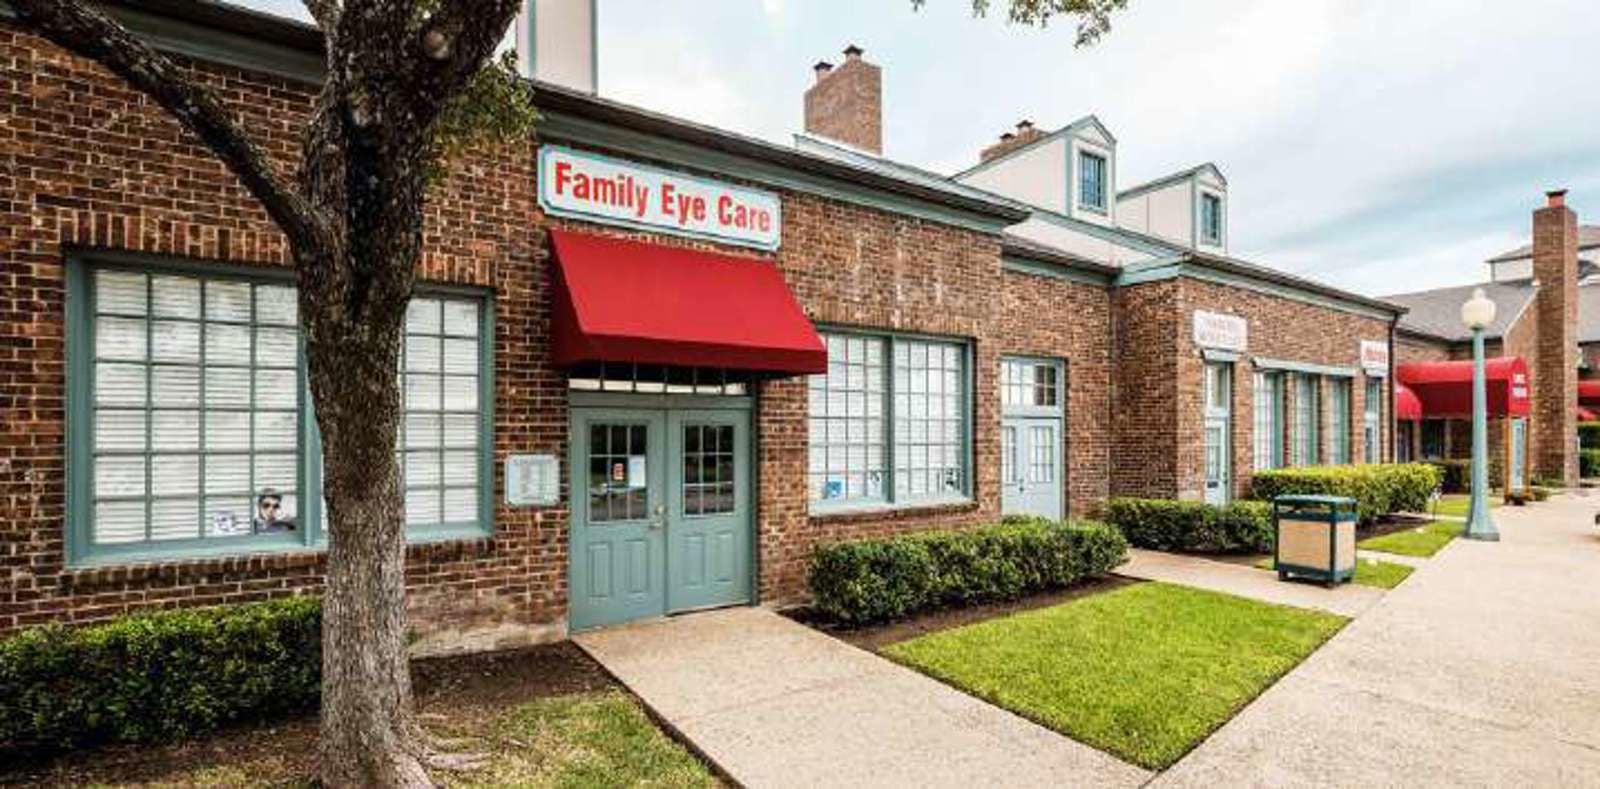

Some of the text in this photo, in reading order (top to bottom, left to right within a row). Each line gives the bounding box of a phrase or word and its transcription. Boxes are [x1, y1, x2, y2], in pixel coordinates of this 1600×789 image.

[554, 161, 771, 233] Family Eye Care
